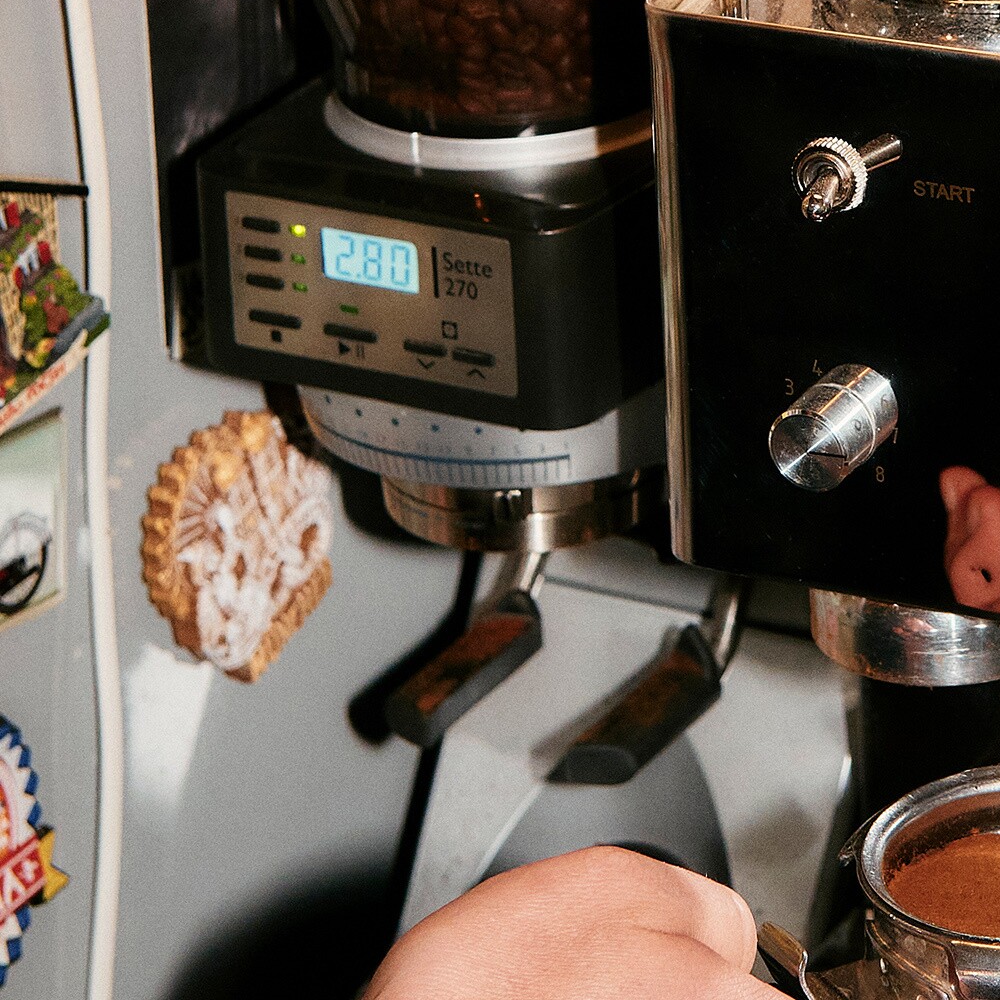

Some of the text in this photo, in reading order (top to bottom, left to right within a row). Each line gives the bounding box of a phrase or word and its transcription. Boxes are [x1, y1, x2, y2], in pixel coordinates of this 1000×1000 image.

[912, 179, 976, 204] START
[335, 234, 411, 287] 2.80
[441, 251, 494, 280] Sette
[444, 277, 479, 301] 270
[784, 378, 795, 396] 3
[875, 465, 886, 483] 8
